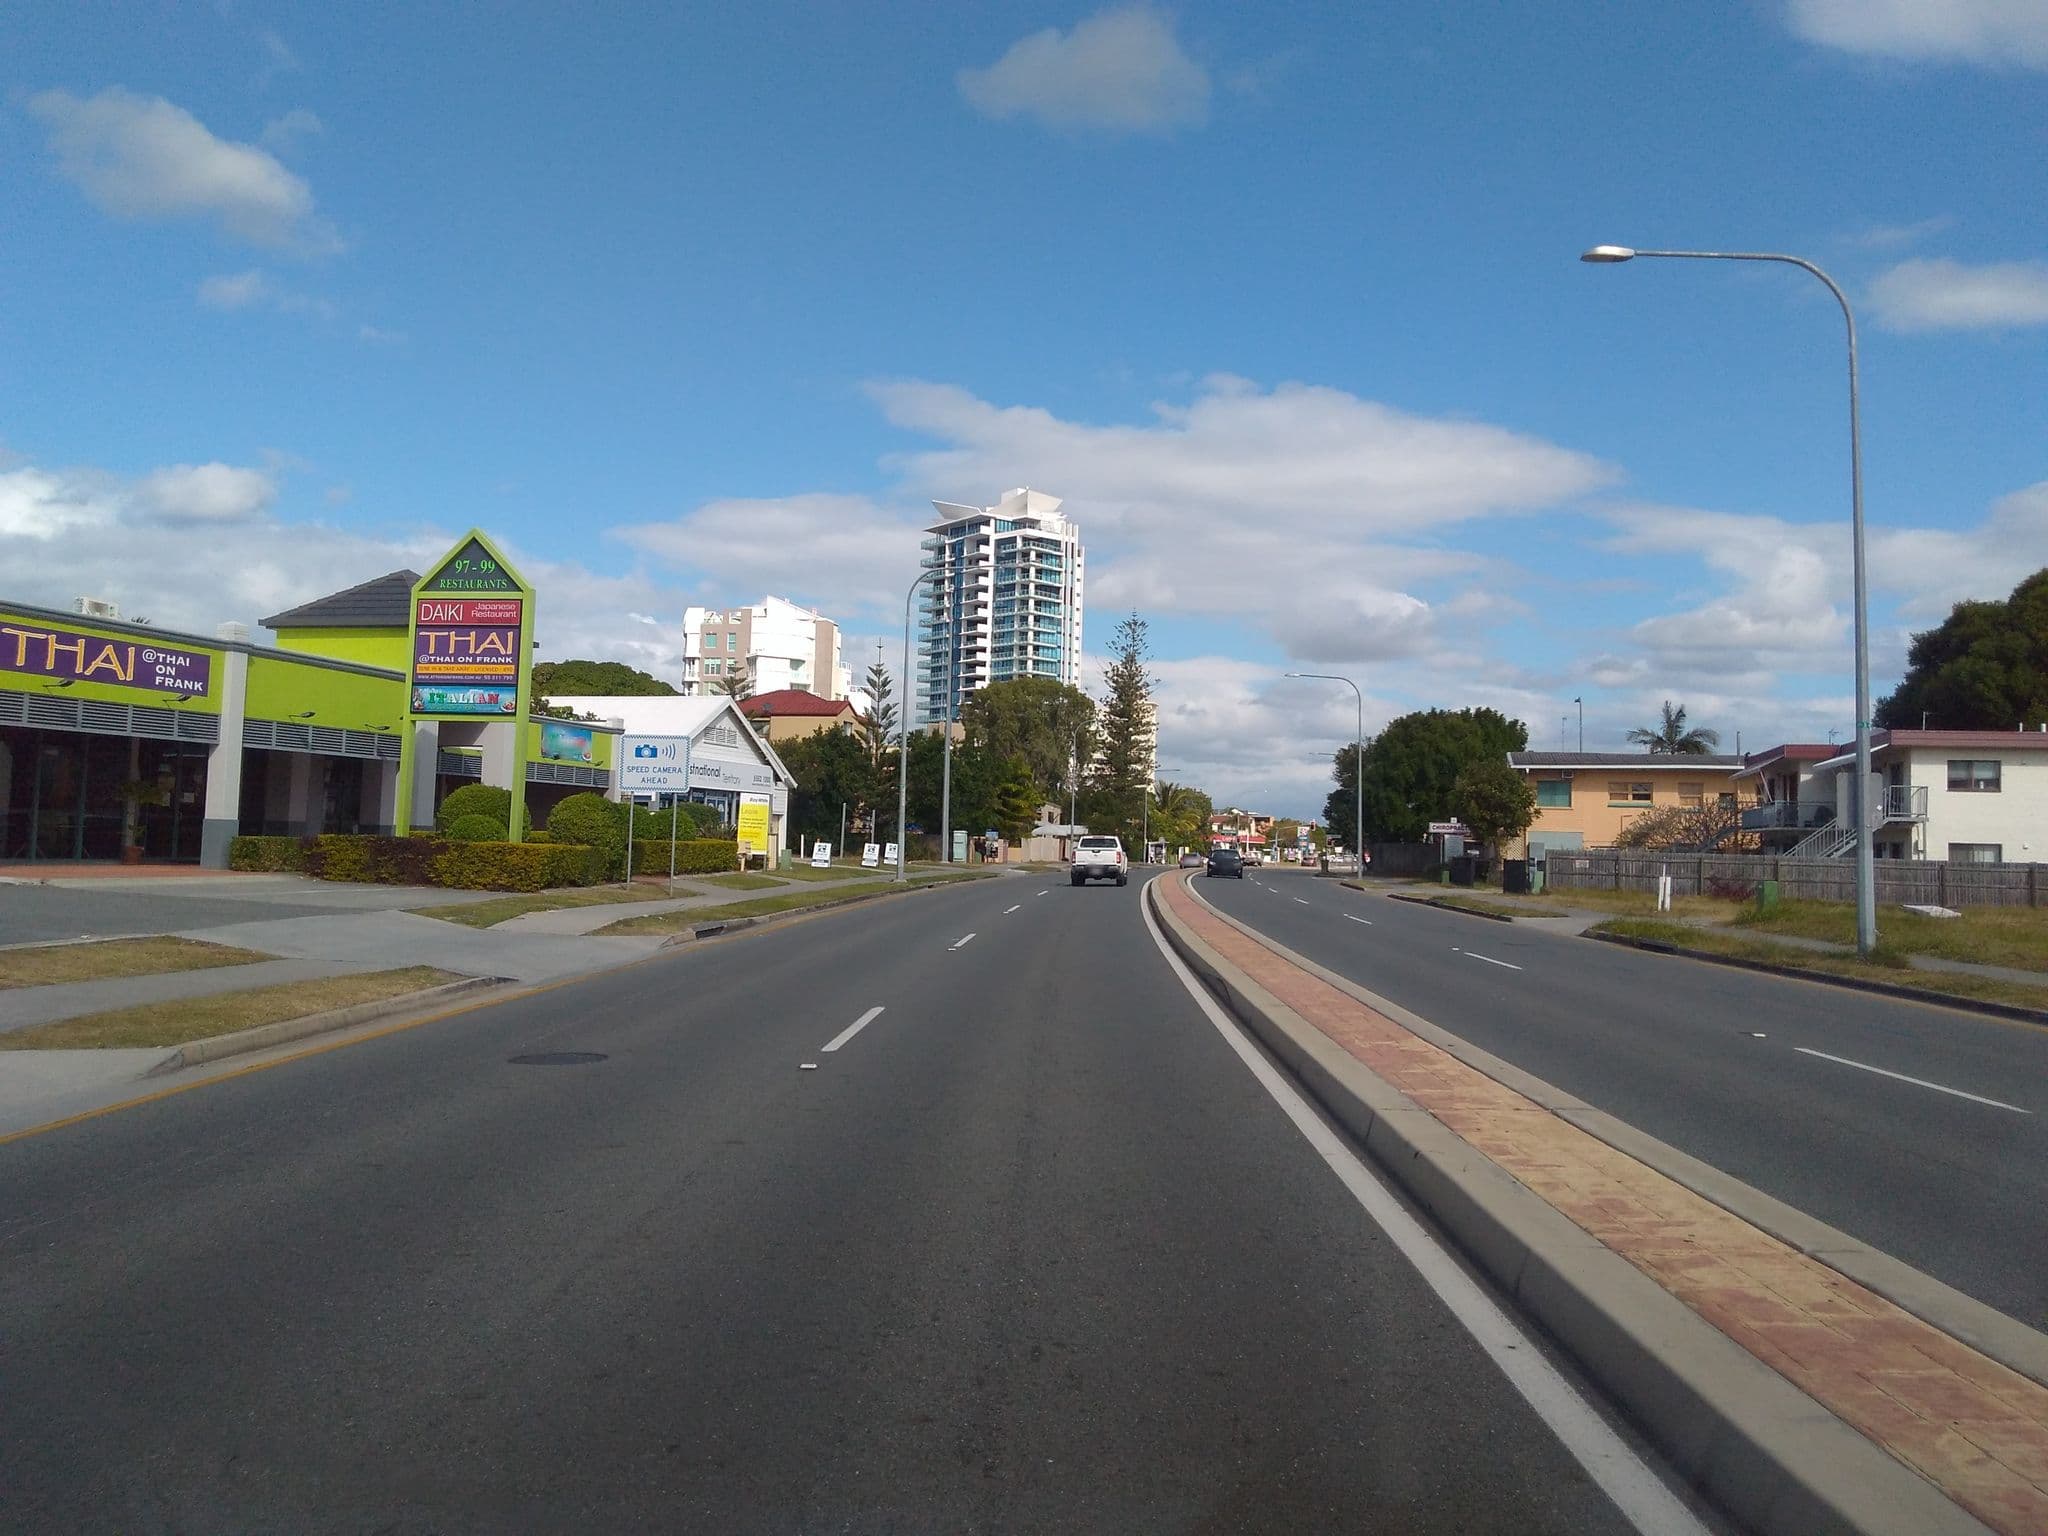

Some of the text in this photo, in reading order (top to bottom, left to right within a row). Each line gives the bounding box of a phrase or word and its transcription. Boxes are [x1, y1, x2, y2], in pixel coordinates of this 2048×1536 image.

[455, 560, 470, 573] 97
[480, 560, 495, 573] 99
[440, 579, 508, 589] RESTAURANTS
[421, 603, 463, 621] DAIKI
[474, 602, 516, 610] Japanese
[471, 610, 517, 618] Restaurant
[419, 631, 514, 655] THAI
[1, 627, 136, 682] THAI
[142, 648, 190, 667] @THAI
[418, 654, 454, 663] @THAI
[476, 656, 513, 664] FRANK
[155, 664, 176, 676] ON
[155, 676, 204, 691] FRANK
[428, 692, 500, 704] ITALIAN
[627, 765, 683, 774] SPEED CAMERA
[689, 763, 721, 778] stnational
[641, 776, 668, 784] AHEAD
